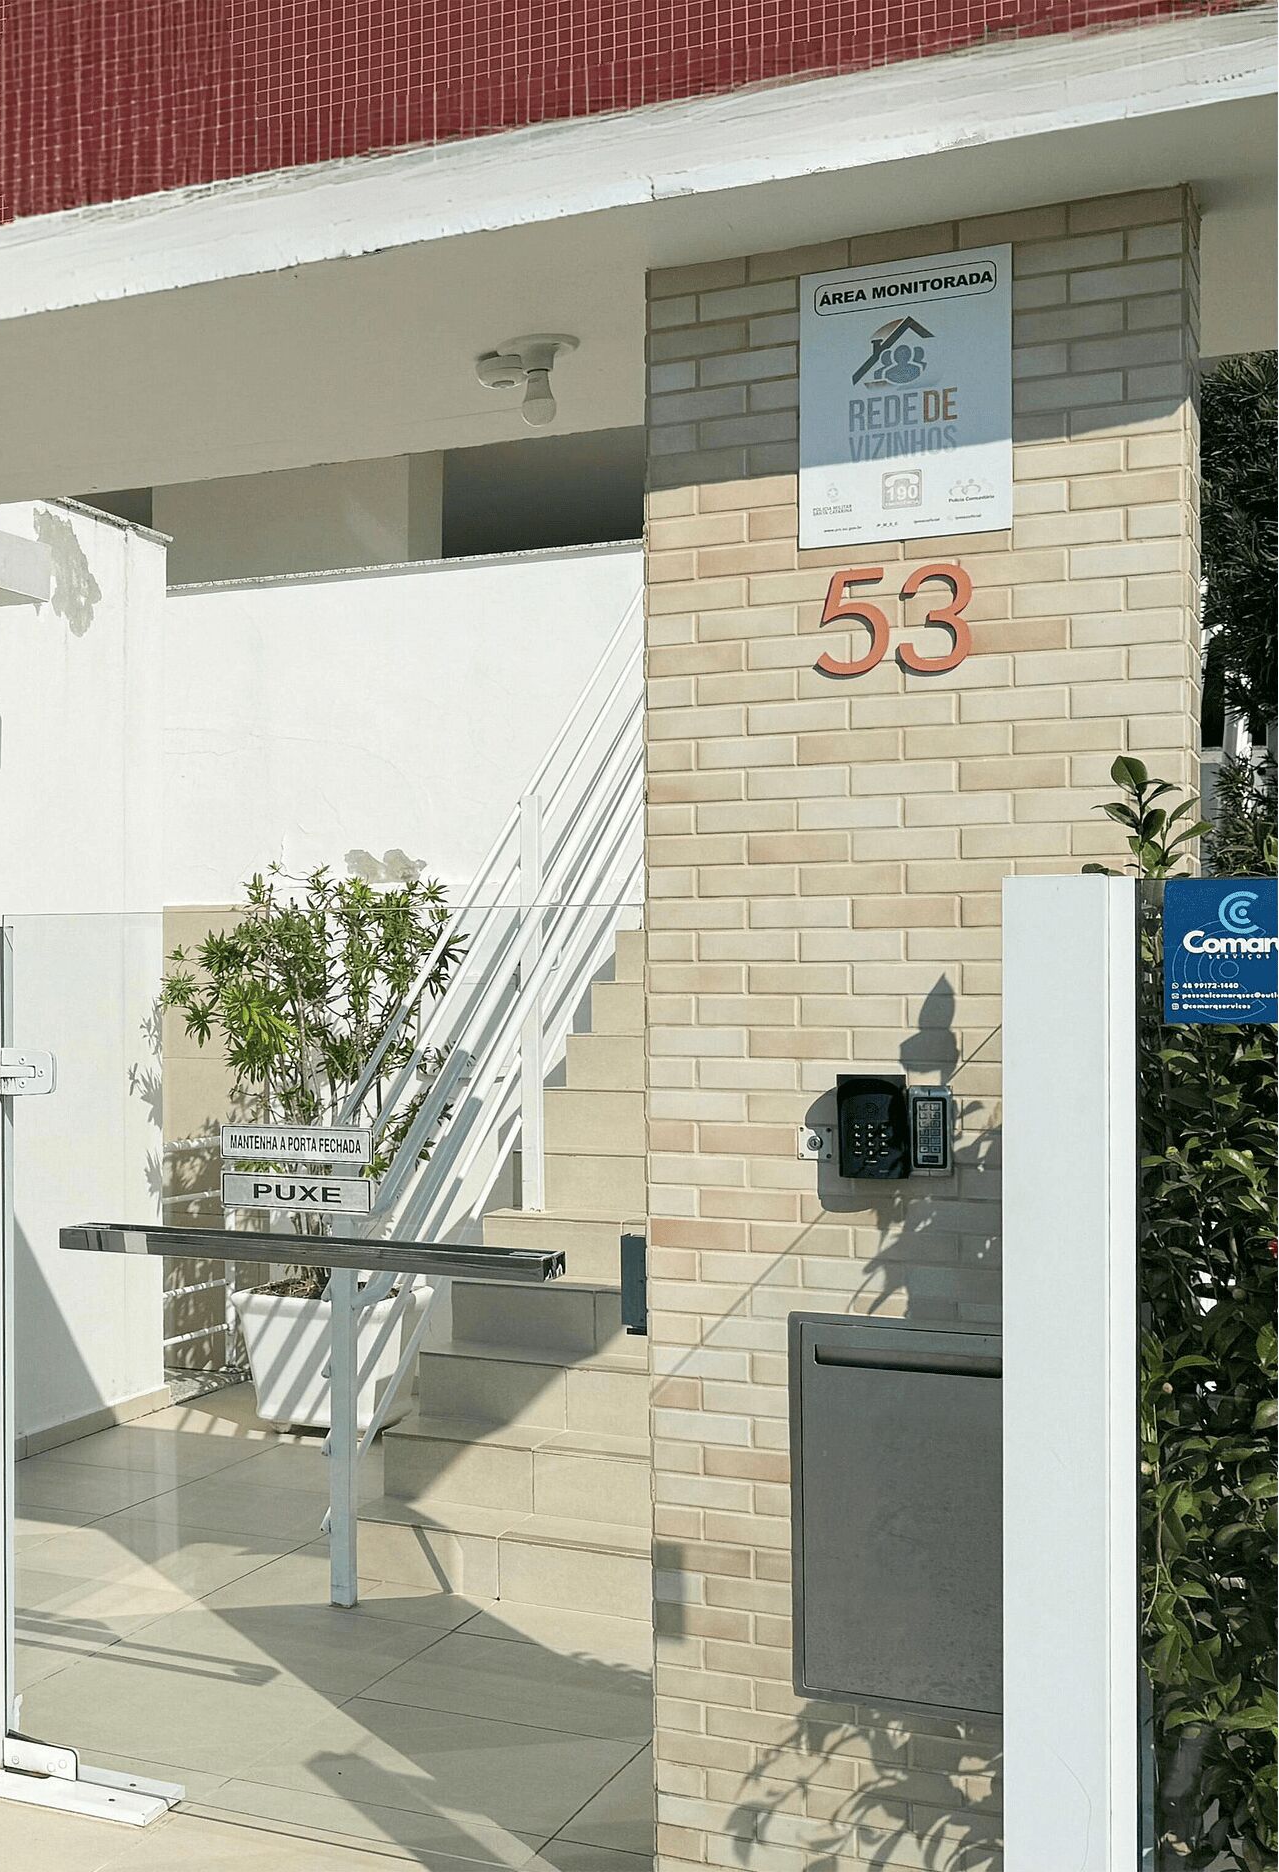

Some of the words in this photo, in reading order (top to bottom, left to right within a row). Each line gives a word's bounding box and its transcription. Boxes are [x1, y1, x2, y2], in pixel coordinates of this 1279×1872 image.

[819, 291, 867, 307] ÁREA
[872, 270, 993, 300] MONITORADA
[849, 392, 918, 432] REDE
[923, 387, 958, 423] DE
[849, 425, 957, 463] VIZINHOS
[885, 484, 919, 502] 190
[815, 563, 973, 676] 53
[1182, 930, 1278, 954] Comar
[230, 1134, 278, 1151] MANTENHA
[280, 1137, 286, 1151] A
[288, 1137, 317, 1152] PORTA
[319, 1138, 362, 1154] FECHADA
[253, 1183, 342, 1204] PUXE
